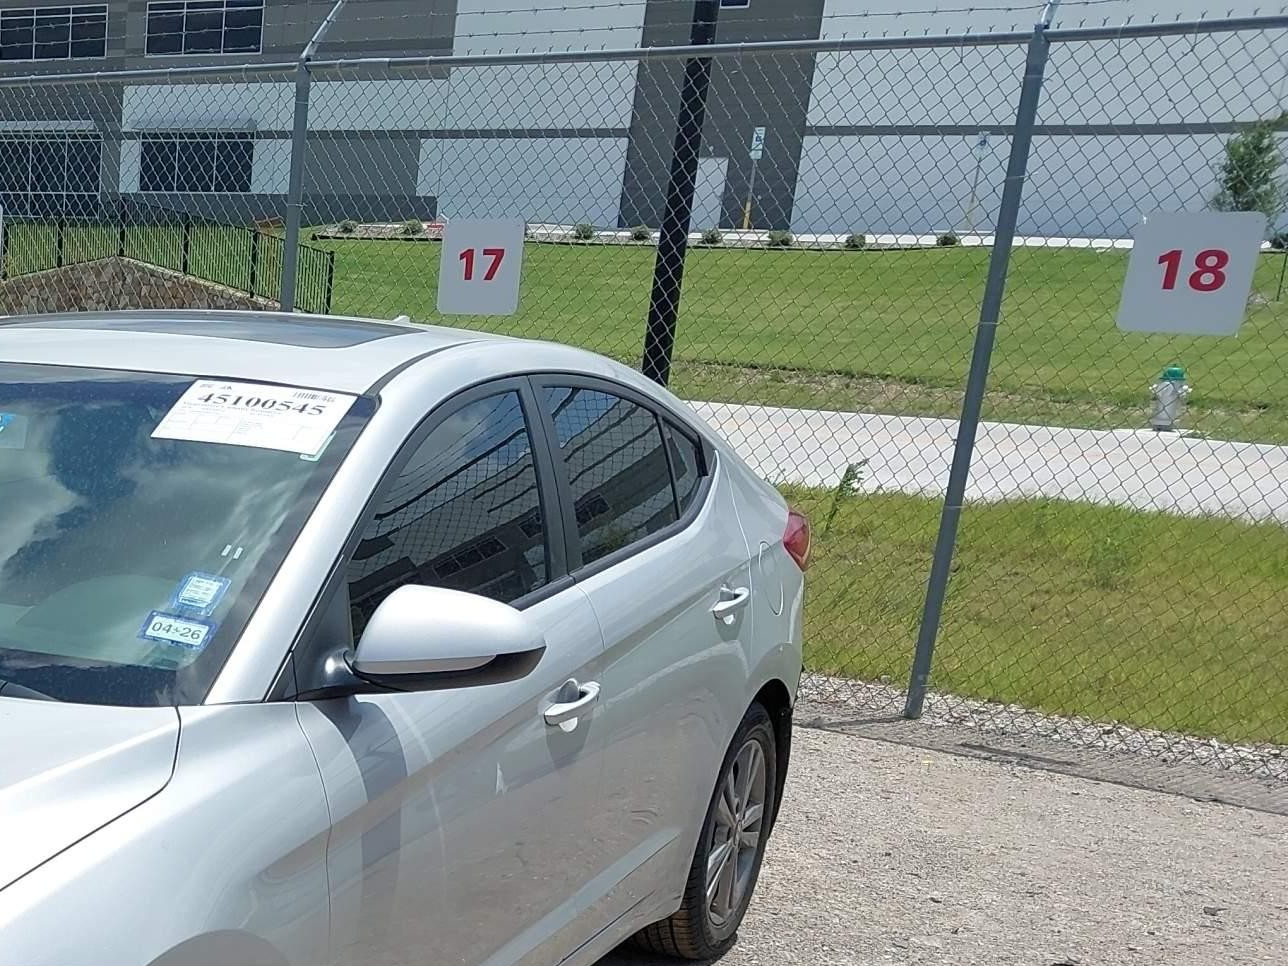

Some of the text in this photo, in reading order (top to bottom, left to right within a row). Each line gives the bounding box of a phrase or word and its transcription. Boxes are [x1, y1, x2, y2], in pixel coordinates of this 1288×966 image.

[459, 248, 506, 282] 17
[1158, 248, 1231, 293] 18
[197, 392, 327, 416] 45100545
